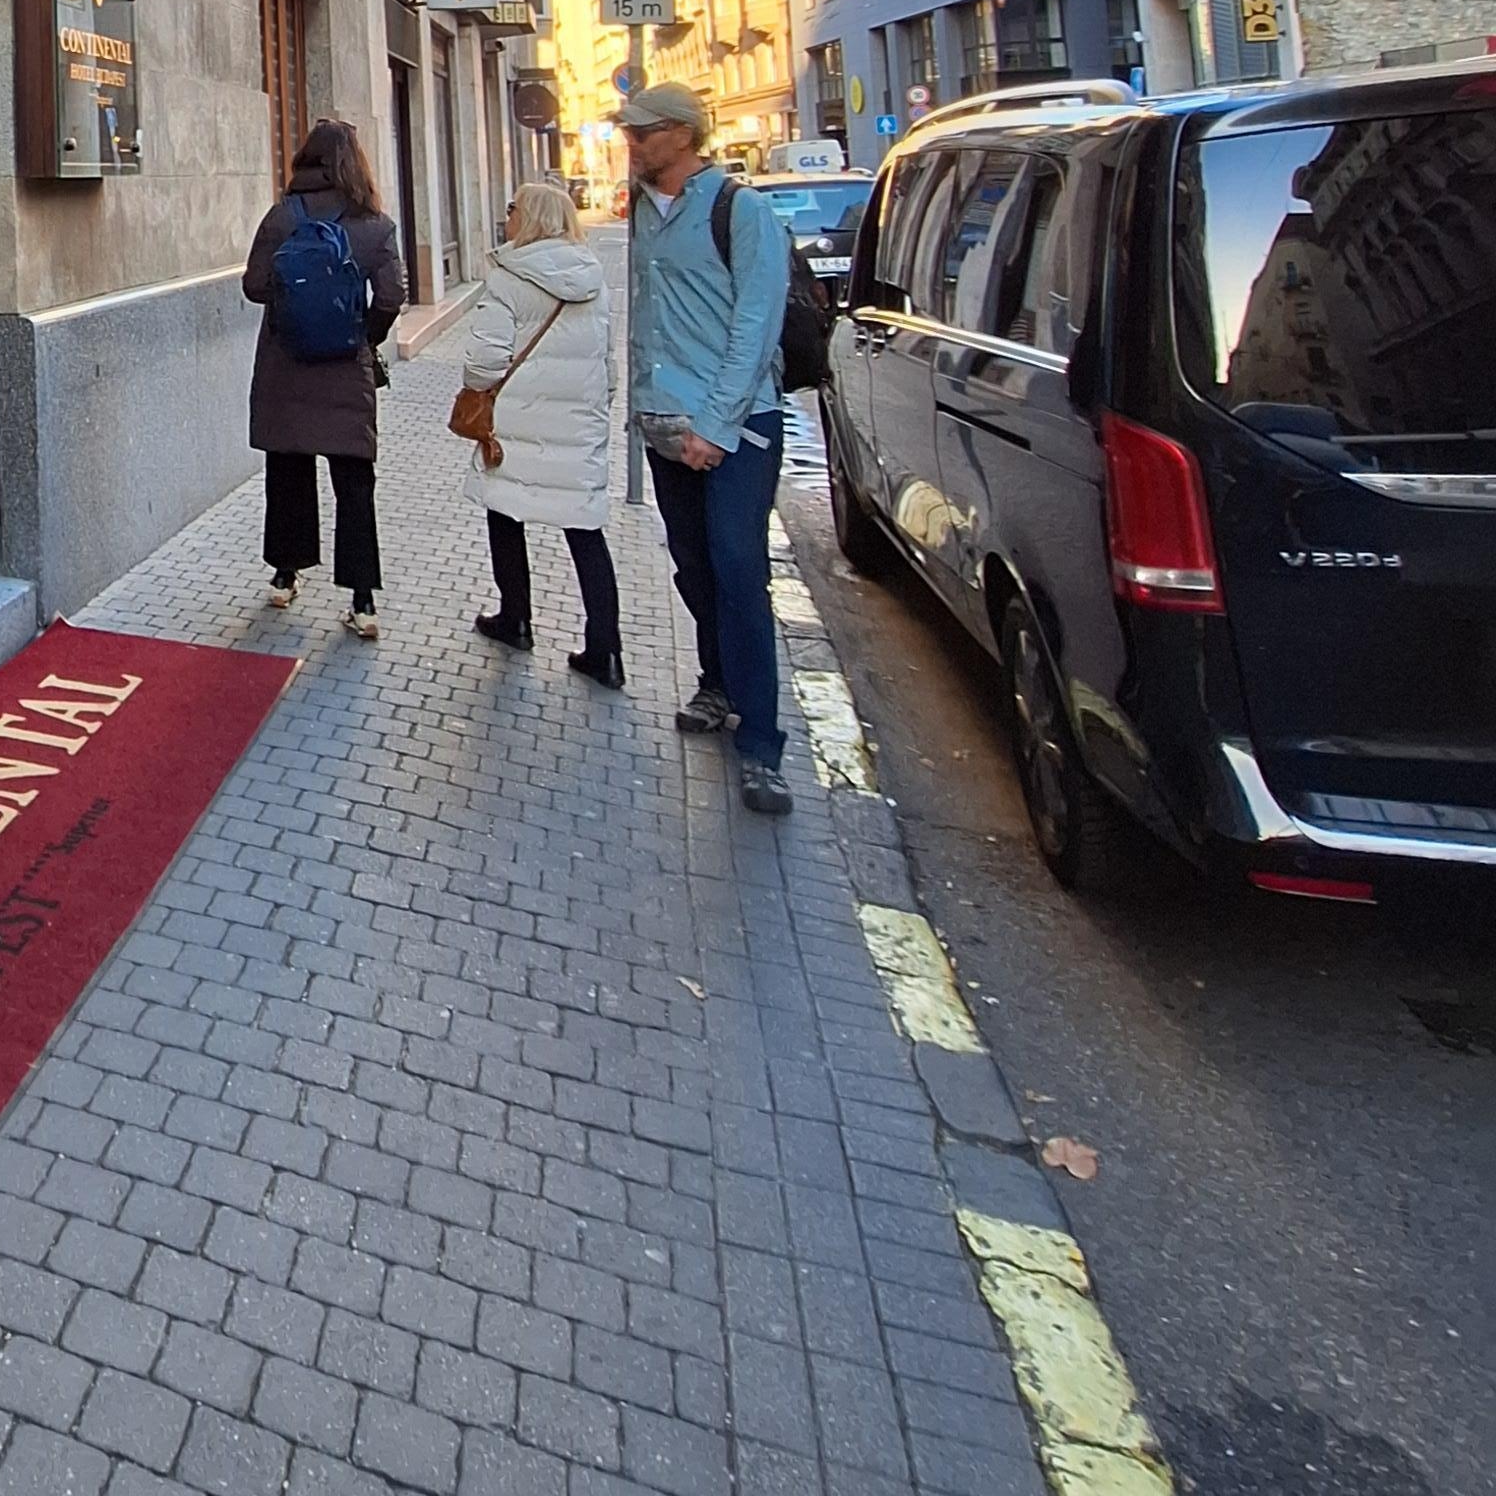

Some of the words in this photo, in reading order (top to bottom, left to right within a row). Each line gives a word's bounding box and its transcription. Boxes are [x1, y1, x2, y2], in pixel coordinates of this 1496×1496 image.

[614, 0, 633, 17] 15
[641, 3, 662, 17] m
[60, 27, 133, 65] CONTINENTAL
[799, 155, 829, 168] GLS
